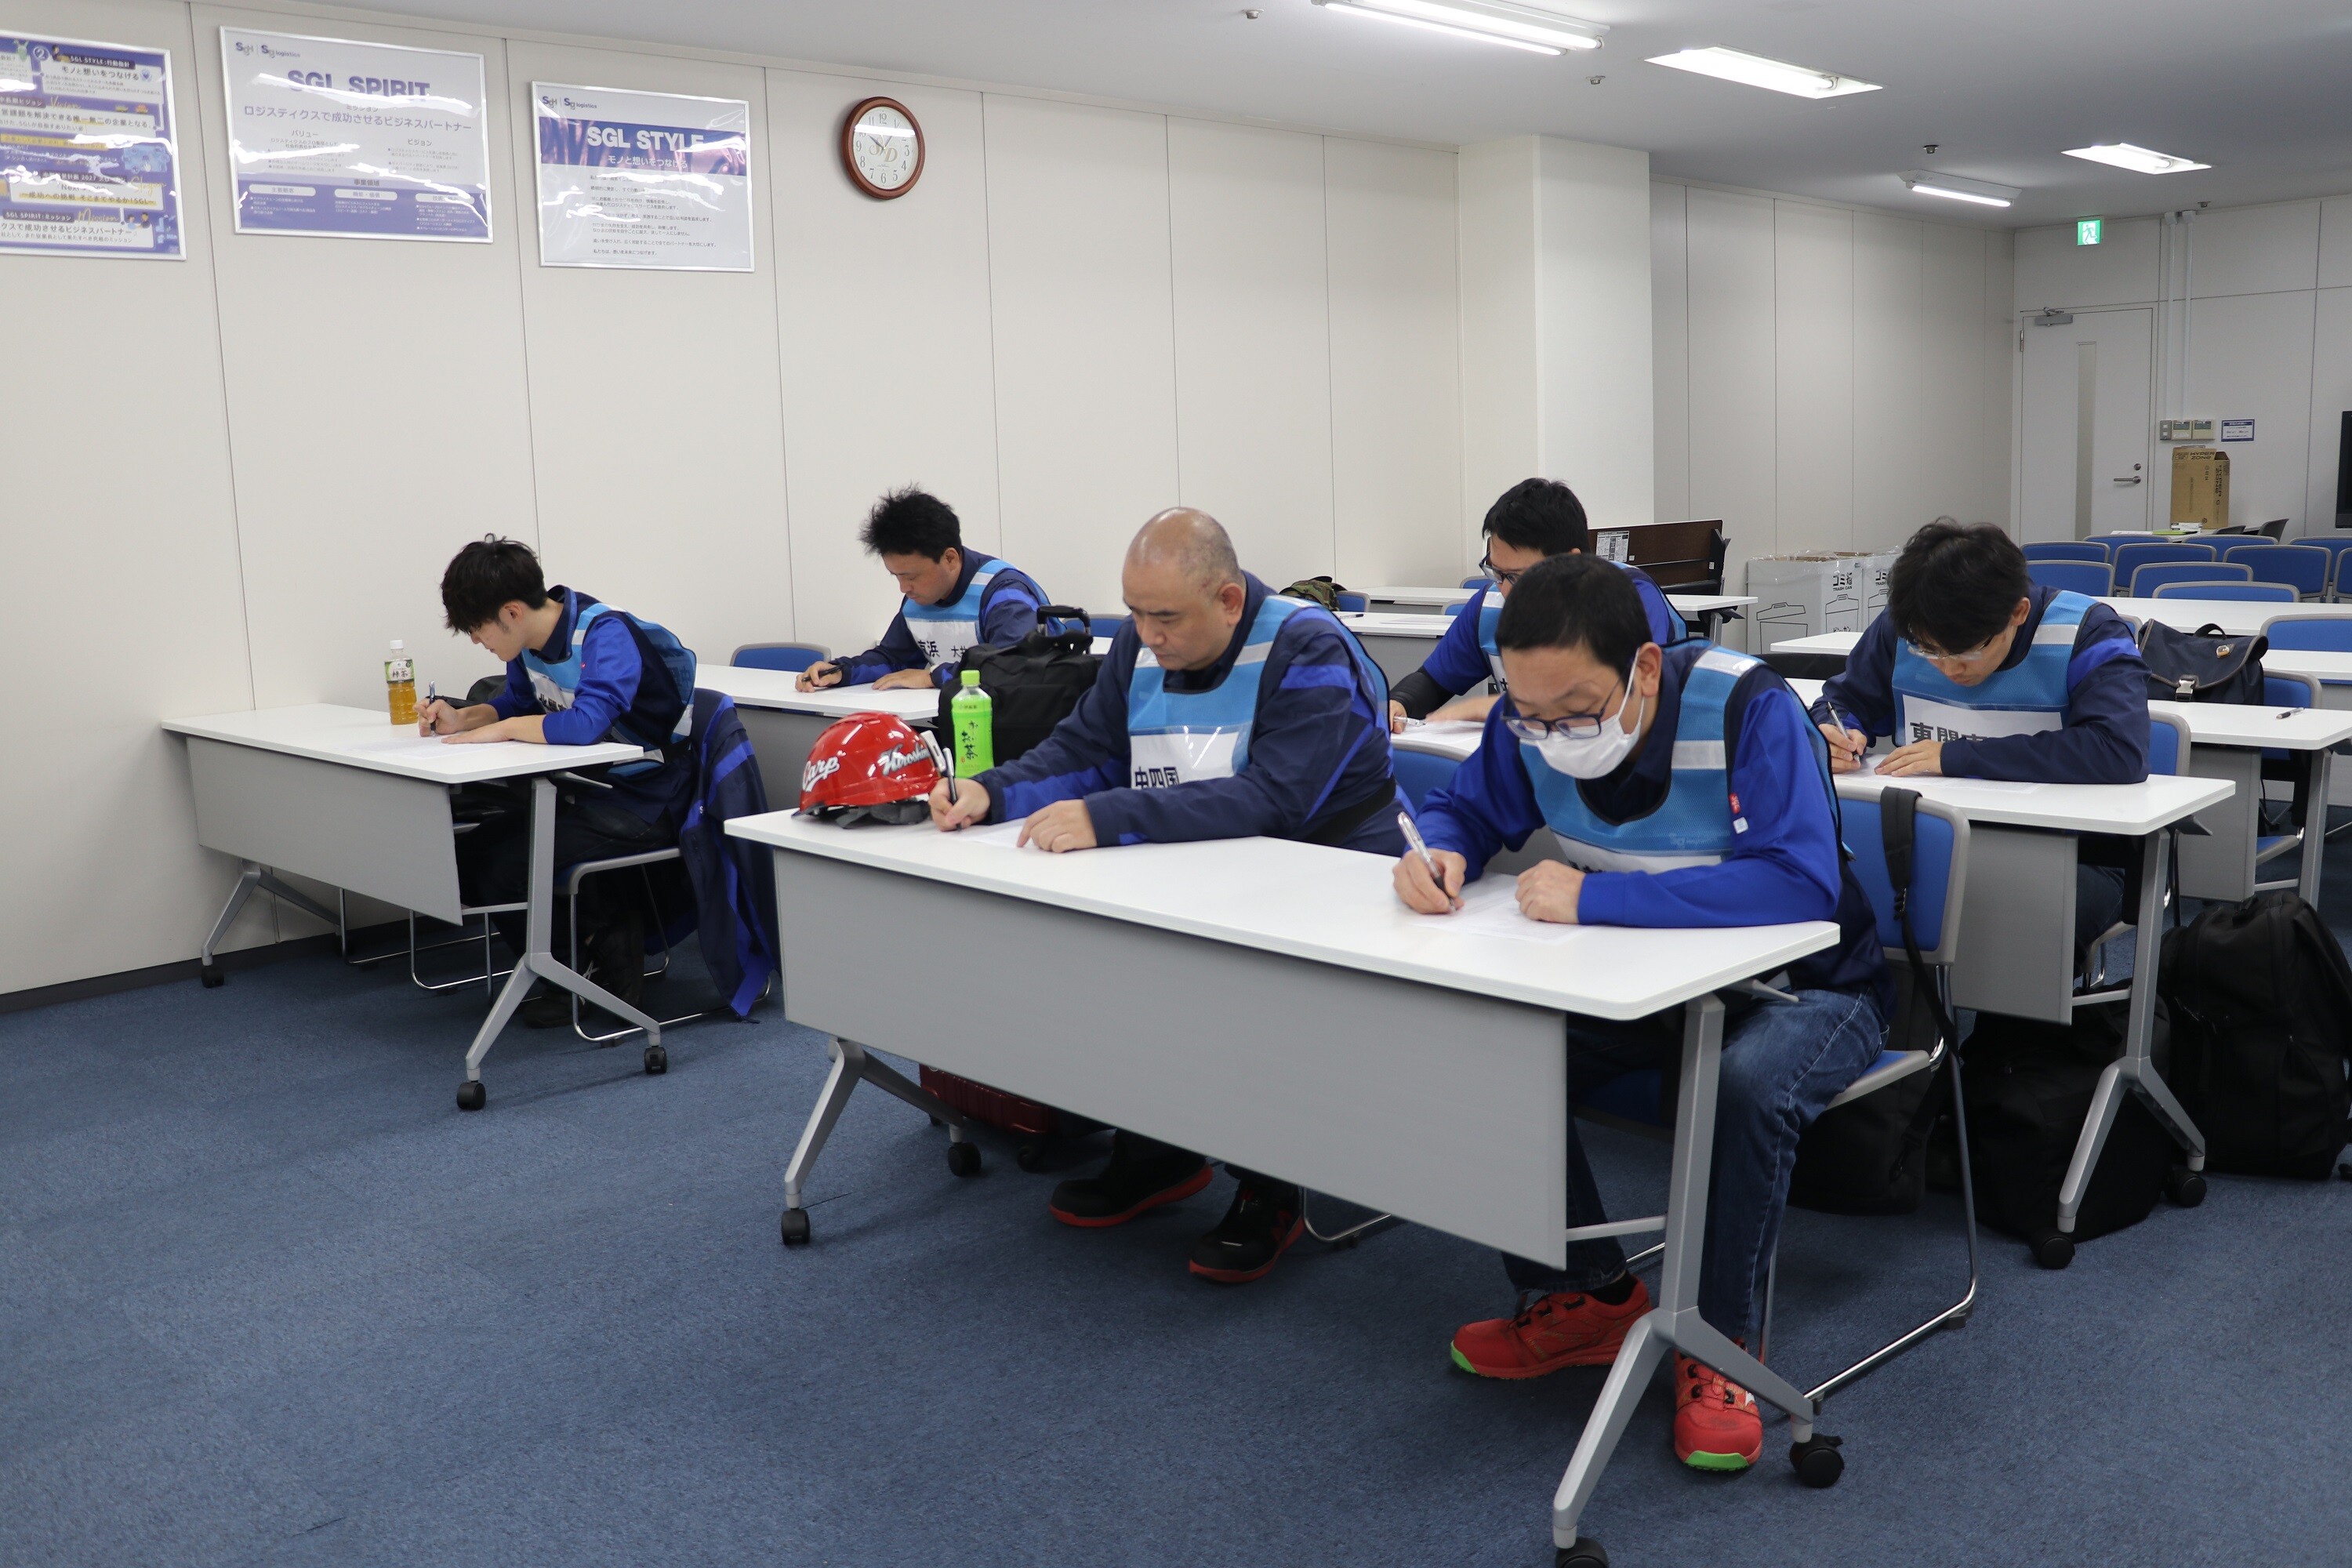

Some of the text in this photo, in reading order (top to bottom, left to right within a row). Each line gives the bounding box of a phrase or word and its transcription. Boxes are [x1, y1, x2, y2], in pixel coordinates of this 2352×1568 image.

[244, 105, 472, 132] ロジスティクスで成功させるビジネスパートナー
[879, 113, 887, 125] 12
[588, 126, 630, 148] SGL
[856, 140, 862, 151] 9
[904, 144, 910, 157] 3
[608, 155, 688, 169] モノと想いをつなげる
[860, 156, 866, 168] 8
[901, 160, 907, 171] 4
[869, 168, 875, 180] 7
[880, 172, 887, 183] 6
[893, 169, 898, 181] 5
[1833, 572, 1853, 587] ゴミ箱
[1875, 569, 1887, 581] ゴミ
[802, 756, 840, 793] Carp
[1134, 766, 1180, 789] 中四国
